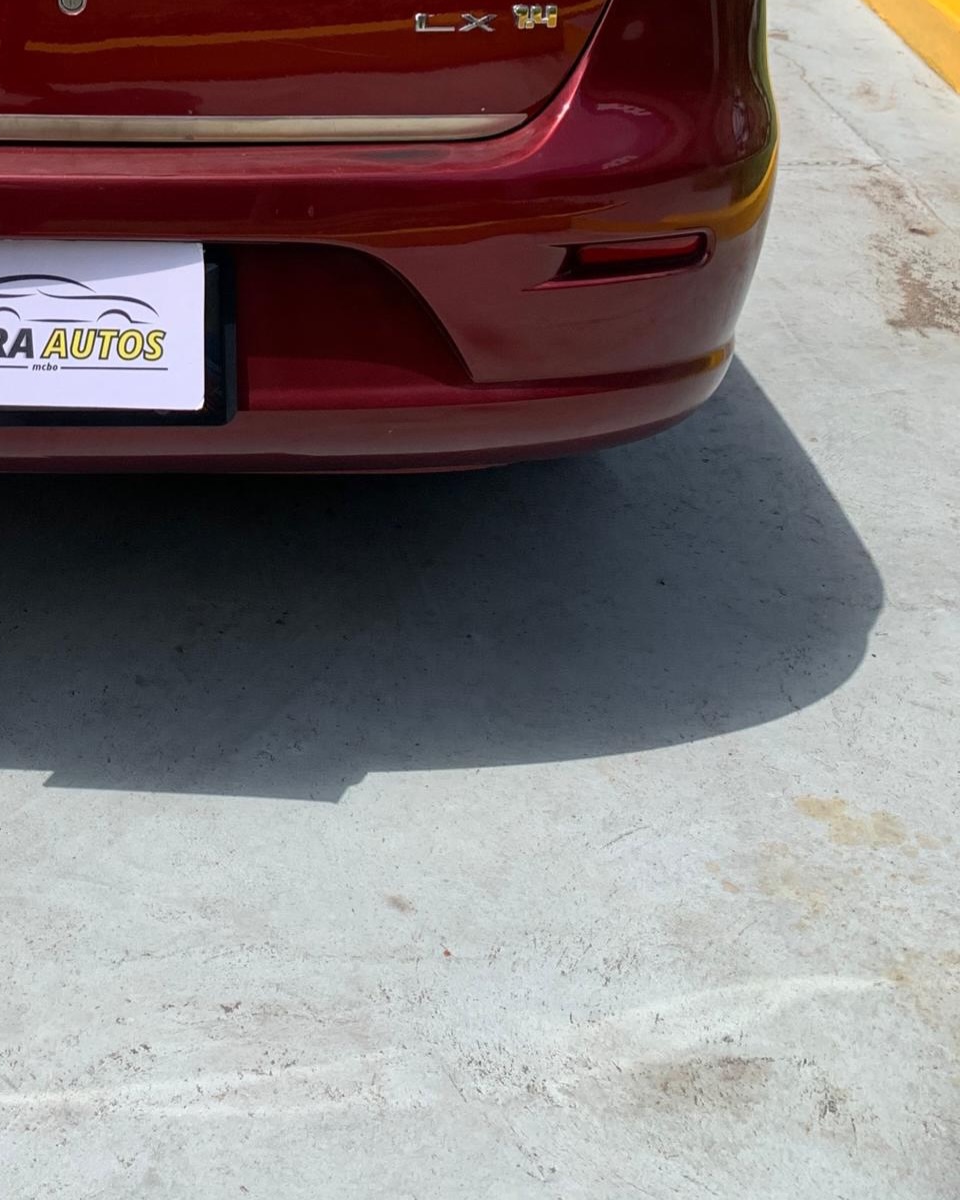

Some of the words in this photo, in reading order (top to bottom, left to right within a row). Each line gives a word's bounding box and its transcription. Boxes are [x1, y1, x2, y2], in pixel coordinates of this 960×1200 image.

[414, 12, 497, 32] LX
[40, 328, 167, 362] AUTOS
[32, 362, 59, 372] mcbo
